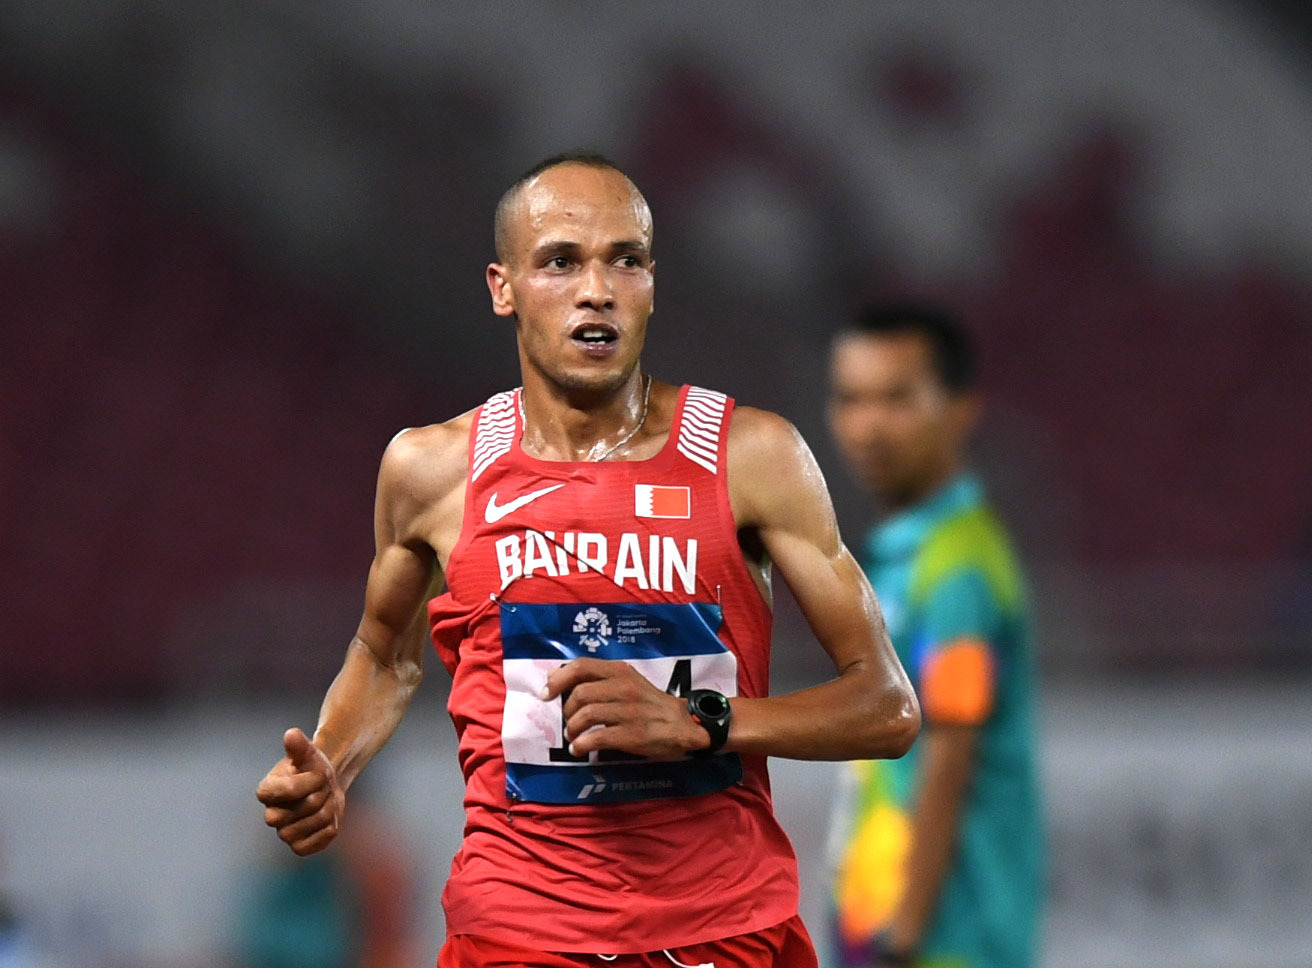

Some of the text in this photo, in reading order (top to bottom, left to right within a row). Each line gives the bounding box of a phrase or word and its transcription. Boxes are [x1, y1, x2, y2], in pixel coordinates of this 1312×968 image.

[495, 529, 698, 595] BAHRAIN
[616, 619, 648, 627] Jakarta
[617, 635, 636, 644] 2018
